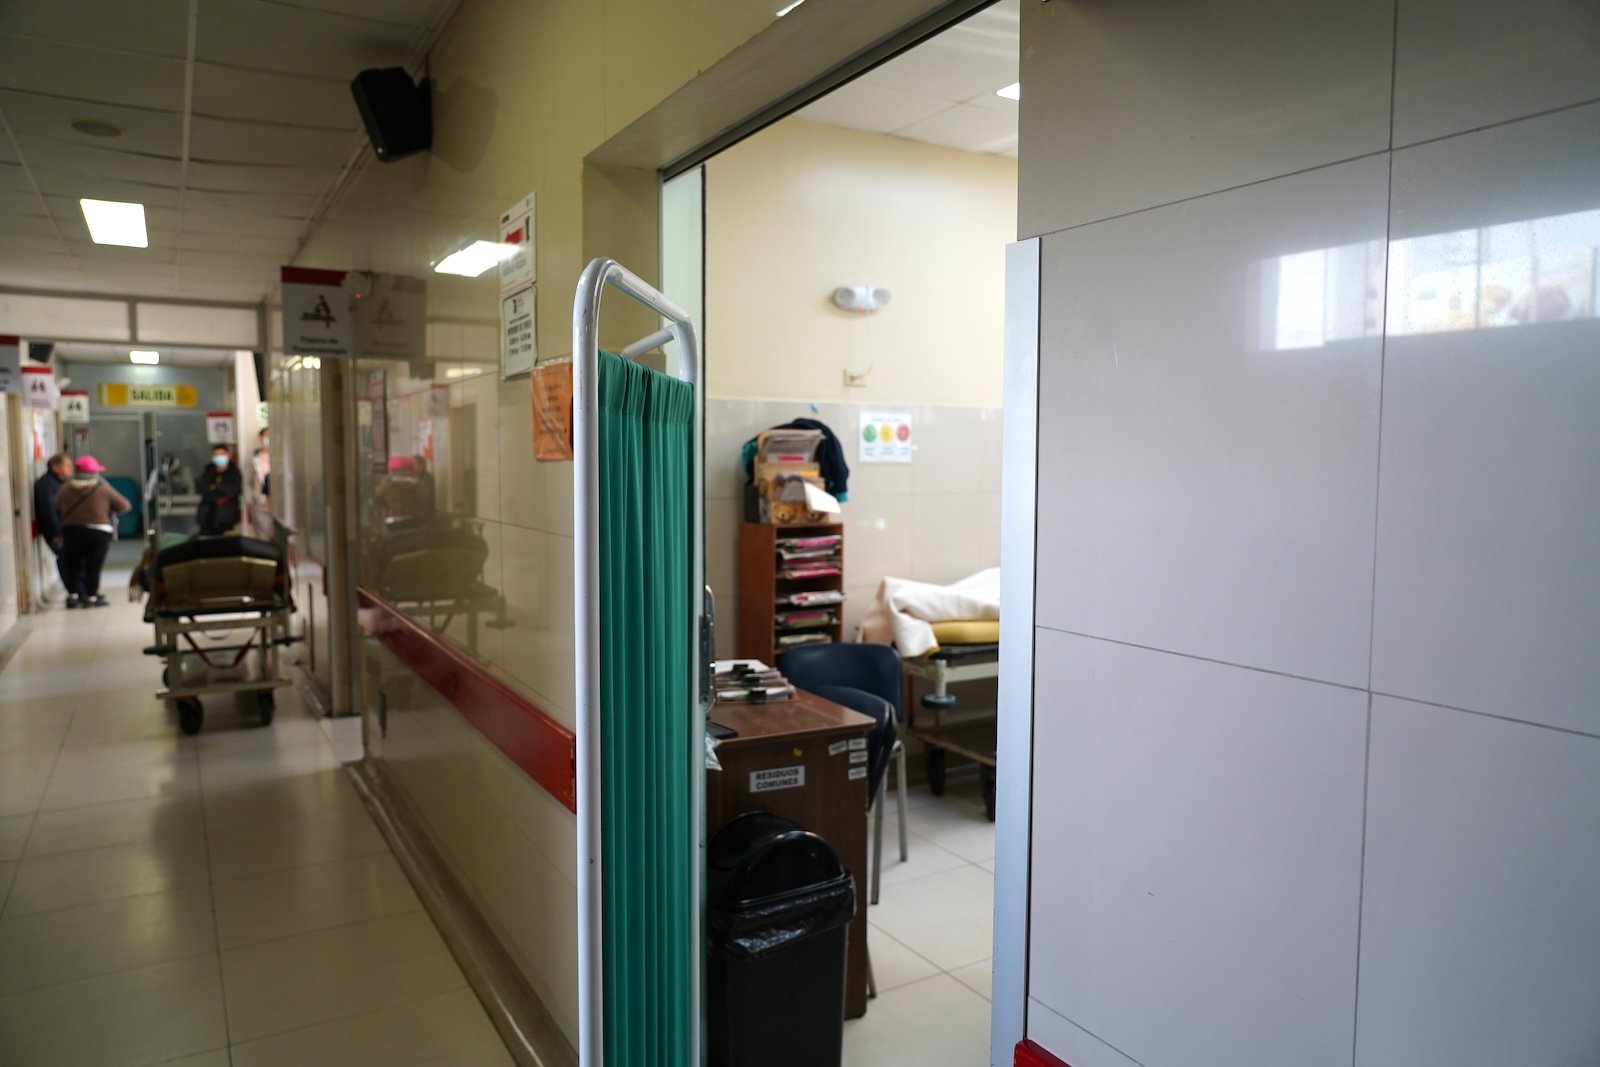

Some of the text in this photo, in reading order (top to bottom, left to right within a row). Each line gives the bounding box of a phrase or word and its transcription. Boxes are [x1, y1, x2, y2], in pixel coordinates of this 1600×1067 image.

[131, 389, 174, 401] SALIDA
[756, 768, 799, 780] RESIDUOS
[756, 777, 798, 790] COMUNES
